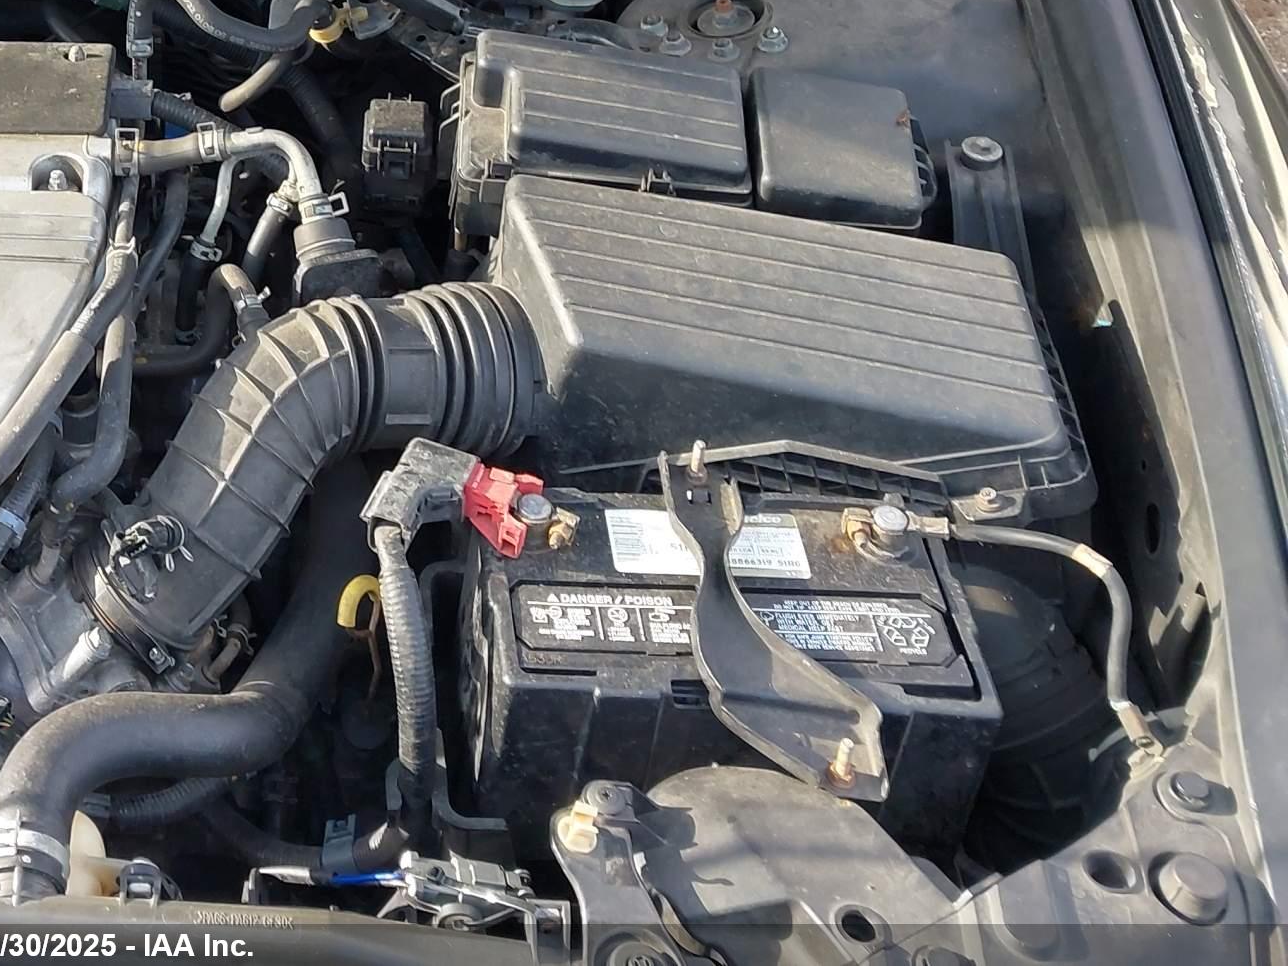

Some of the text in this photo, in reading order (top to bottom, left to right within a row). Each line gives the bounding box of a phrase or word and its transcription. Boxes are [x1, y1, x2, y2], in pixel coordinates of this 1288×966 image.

[562, 593, 673, 606] DANGER / POISON
